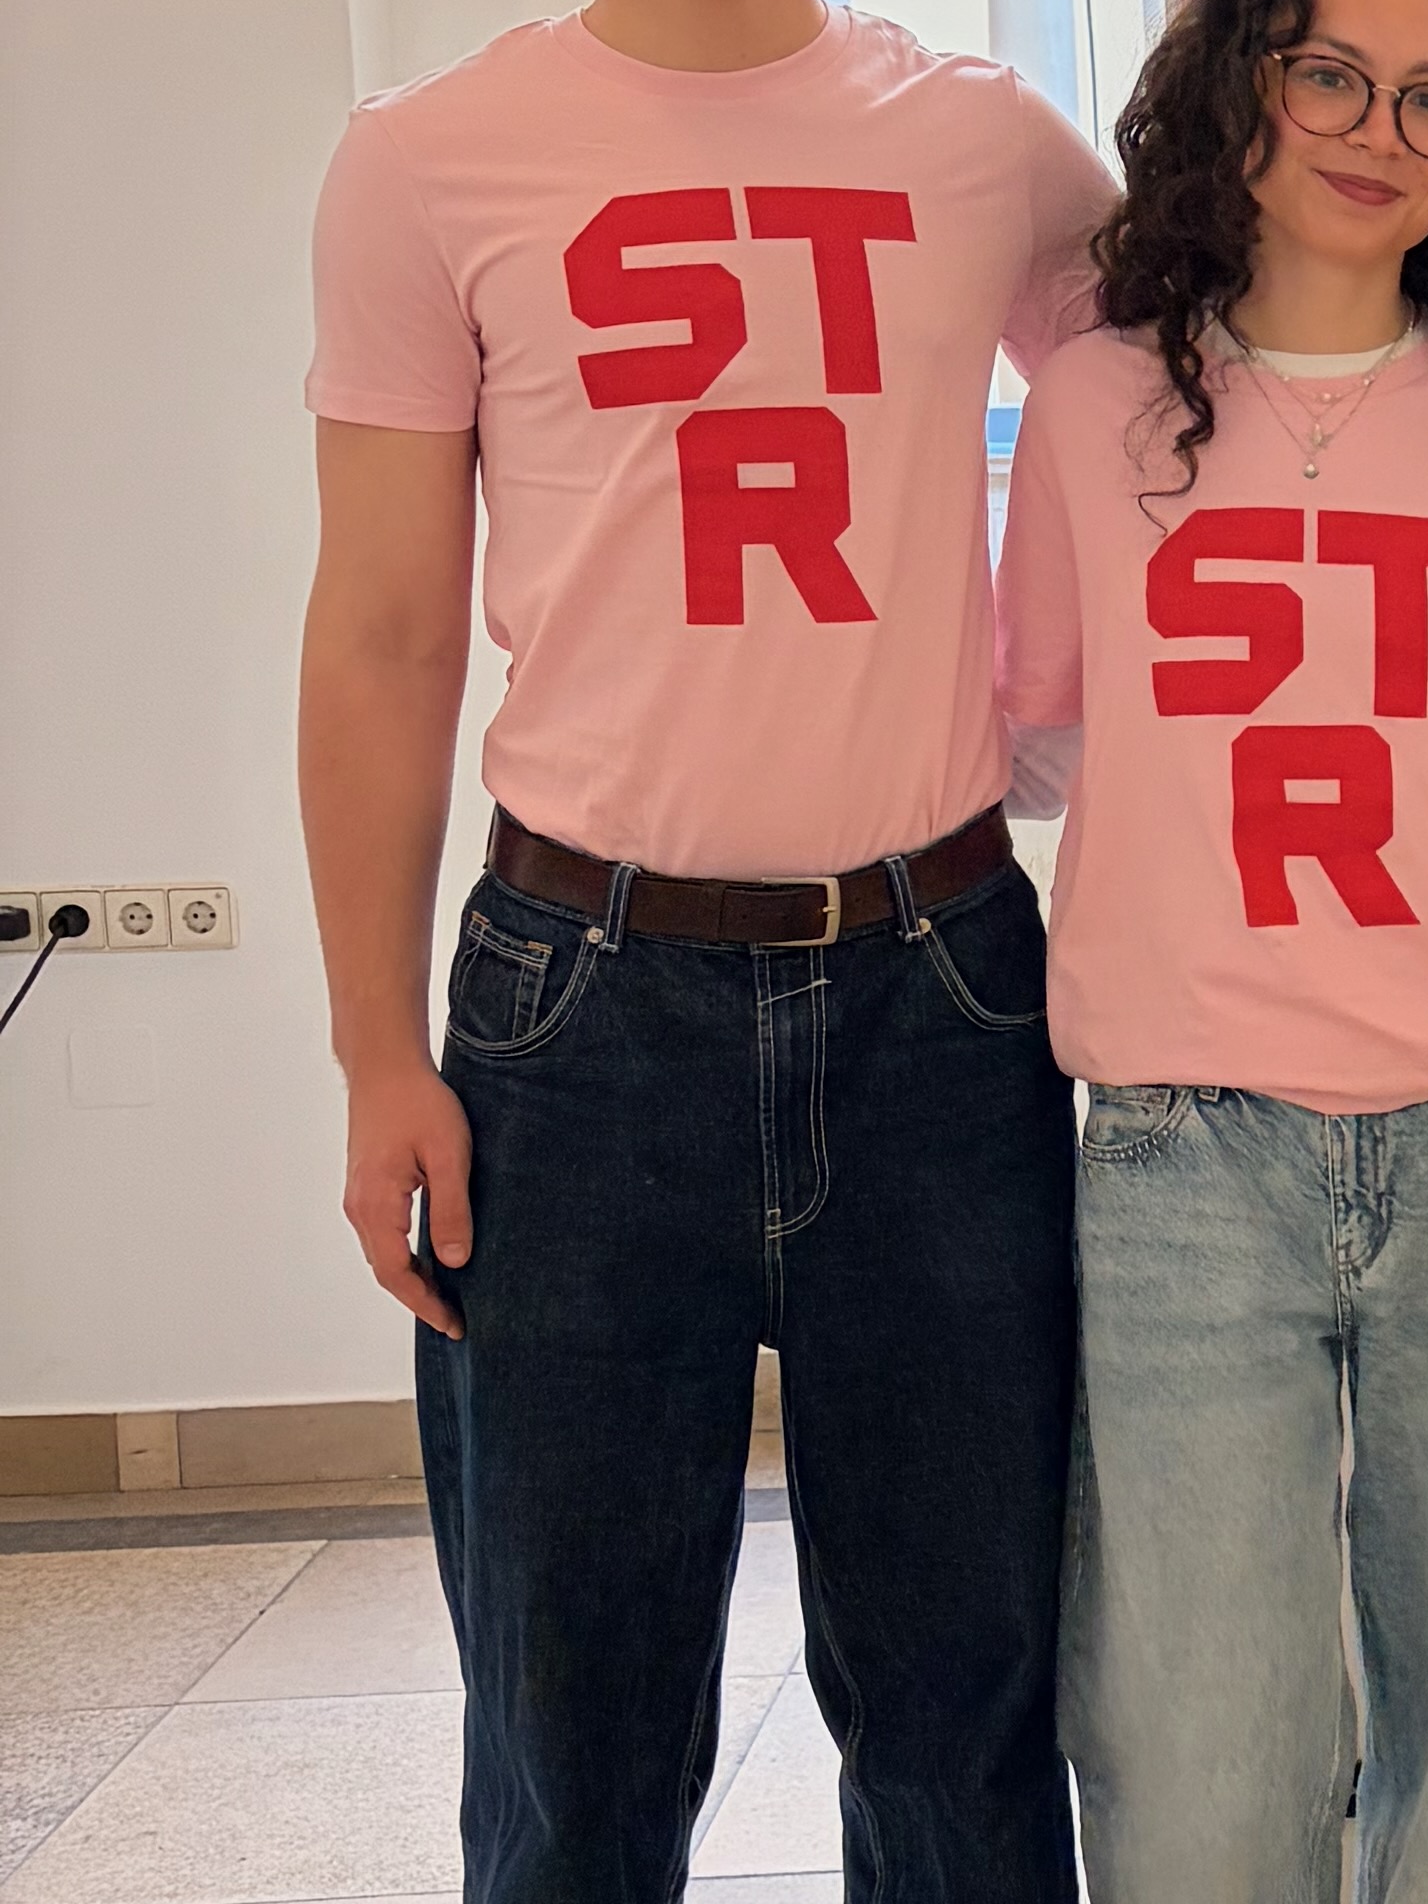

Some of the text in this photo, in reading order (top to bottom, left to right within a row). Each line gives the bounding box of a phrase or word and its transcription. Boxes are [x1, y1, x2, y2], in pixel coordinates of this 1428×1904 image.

[563, 186, 917, 410] ST
[676, 407, 879, 625] R
[1231, 725, 1421, 927] R
